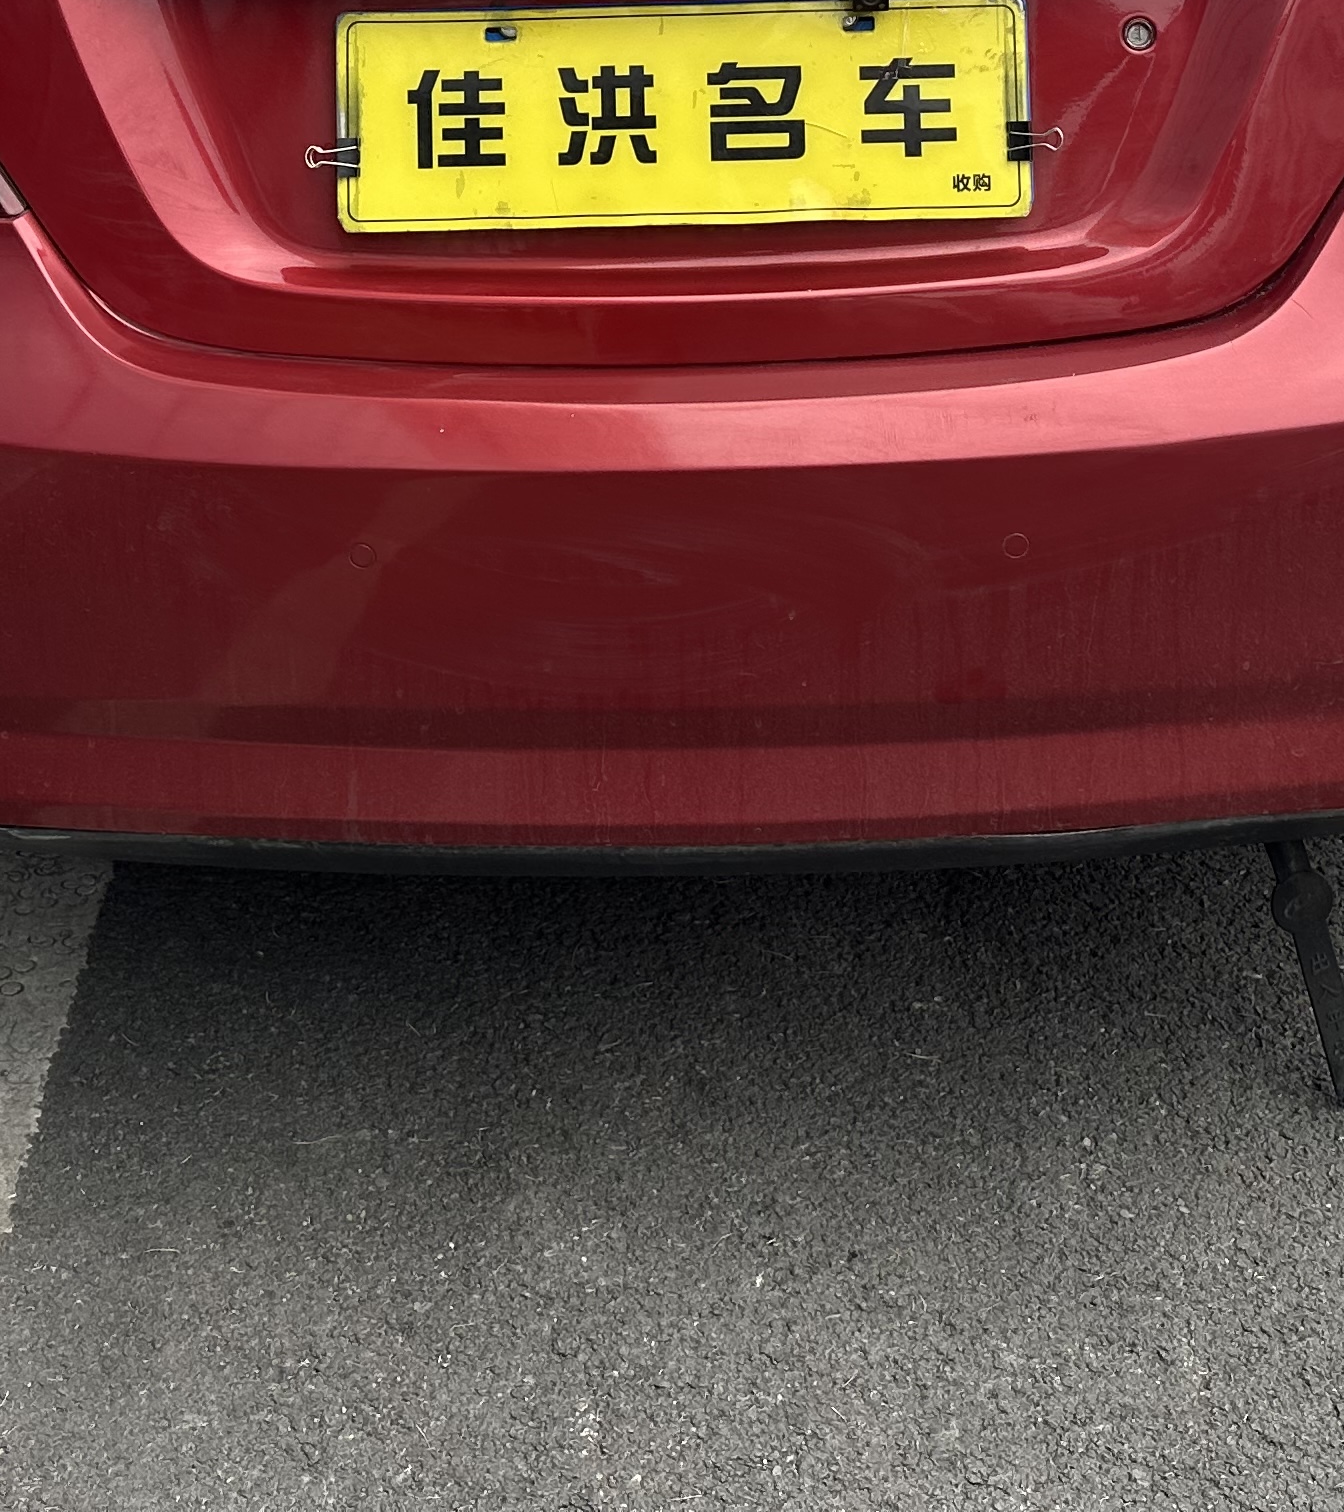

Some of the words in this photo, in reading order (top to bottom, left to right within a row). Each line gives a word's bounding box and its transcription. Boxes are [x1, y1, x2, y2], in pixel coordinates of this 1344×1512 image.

[406, 56, 958, 170] 佳洪名车
[952, 173, 992, 193] 收购
